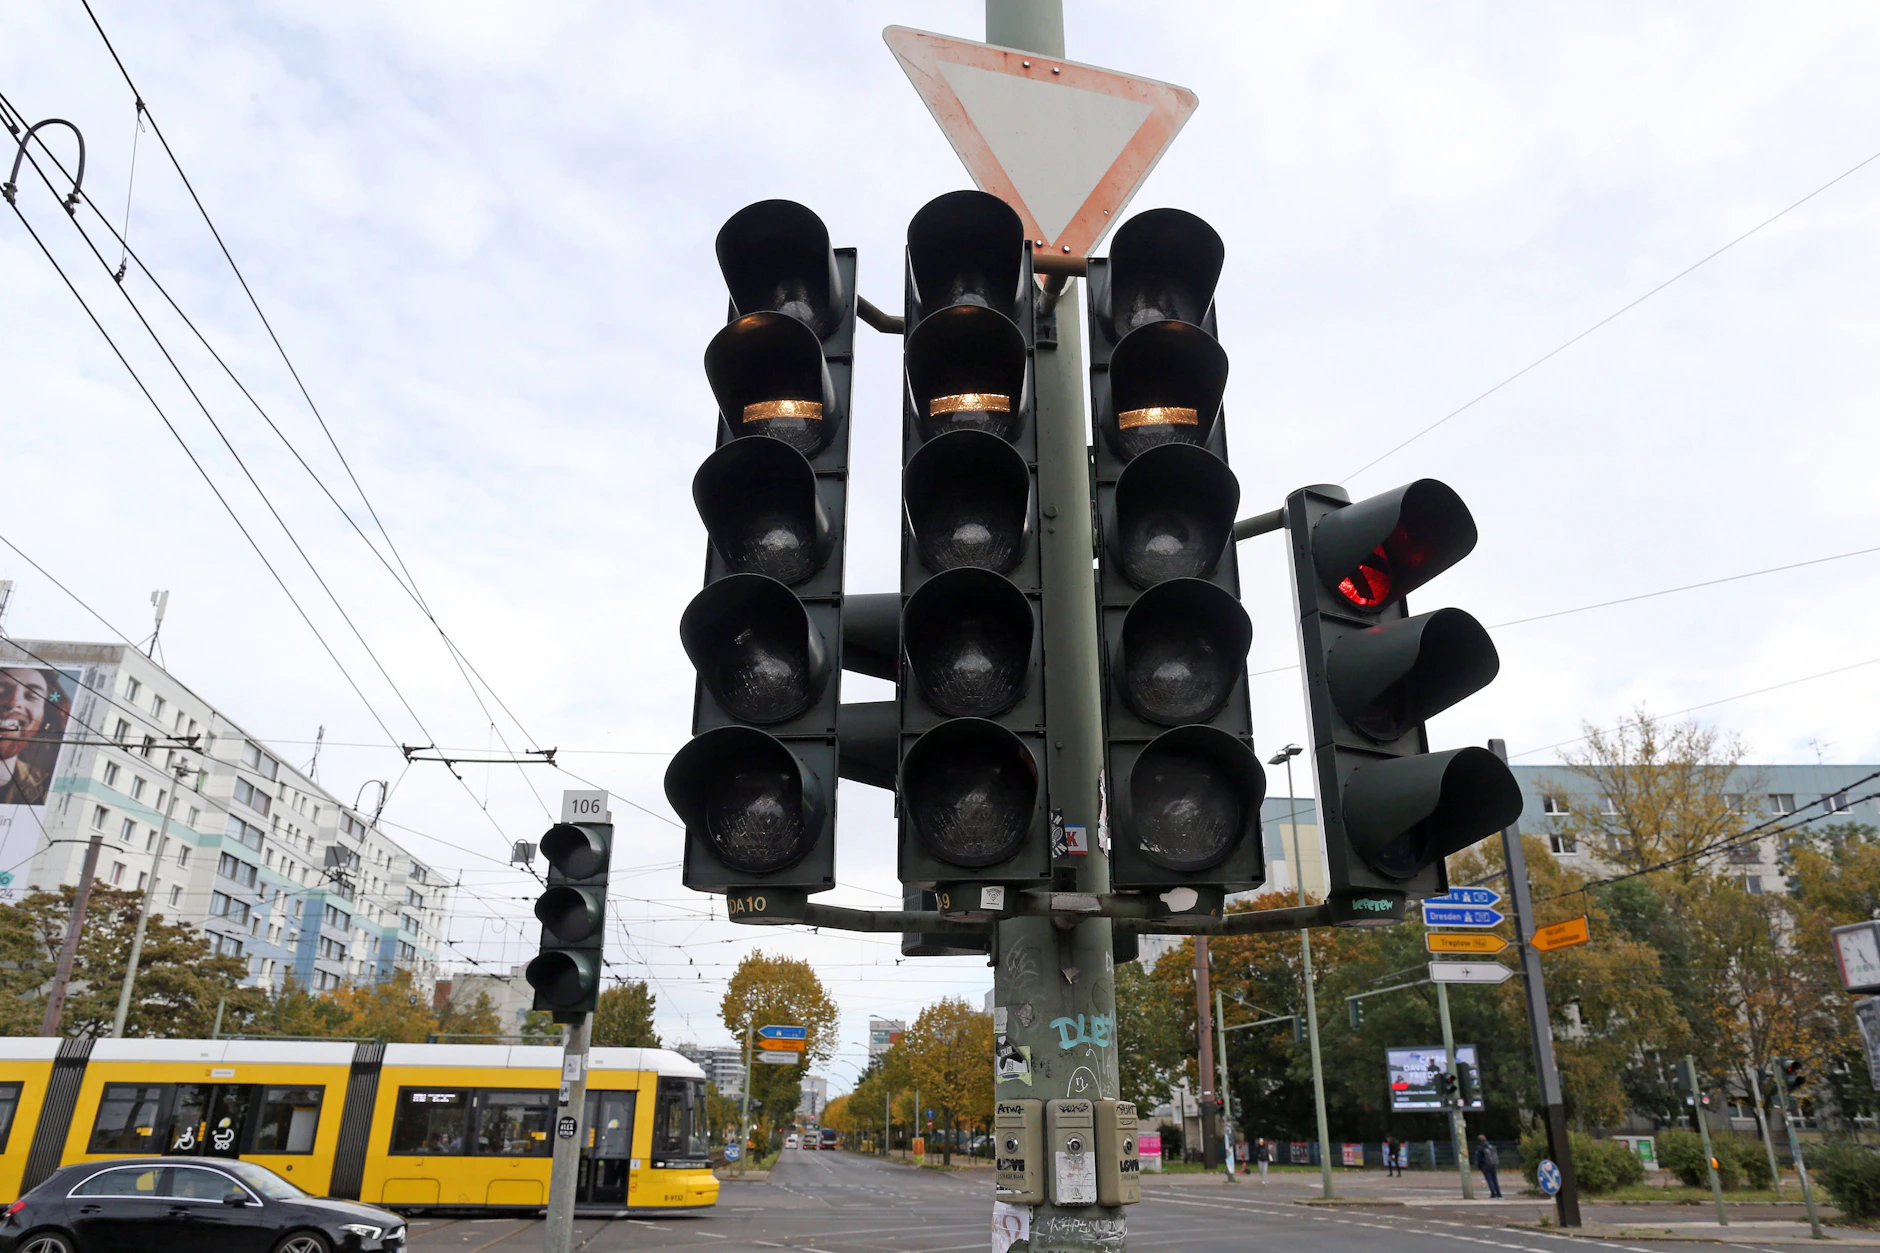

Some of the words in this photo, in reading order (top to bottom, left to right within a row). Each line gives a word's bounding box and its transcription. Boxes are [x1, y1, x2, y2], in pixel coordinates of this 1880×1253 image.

[572, 799, 600, 814] 106
[1430, 911, 1462, 920] Dresden
[1441, 938, 1471, 948] Treptow
